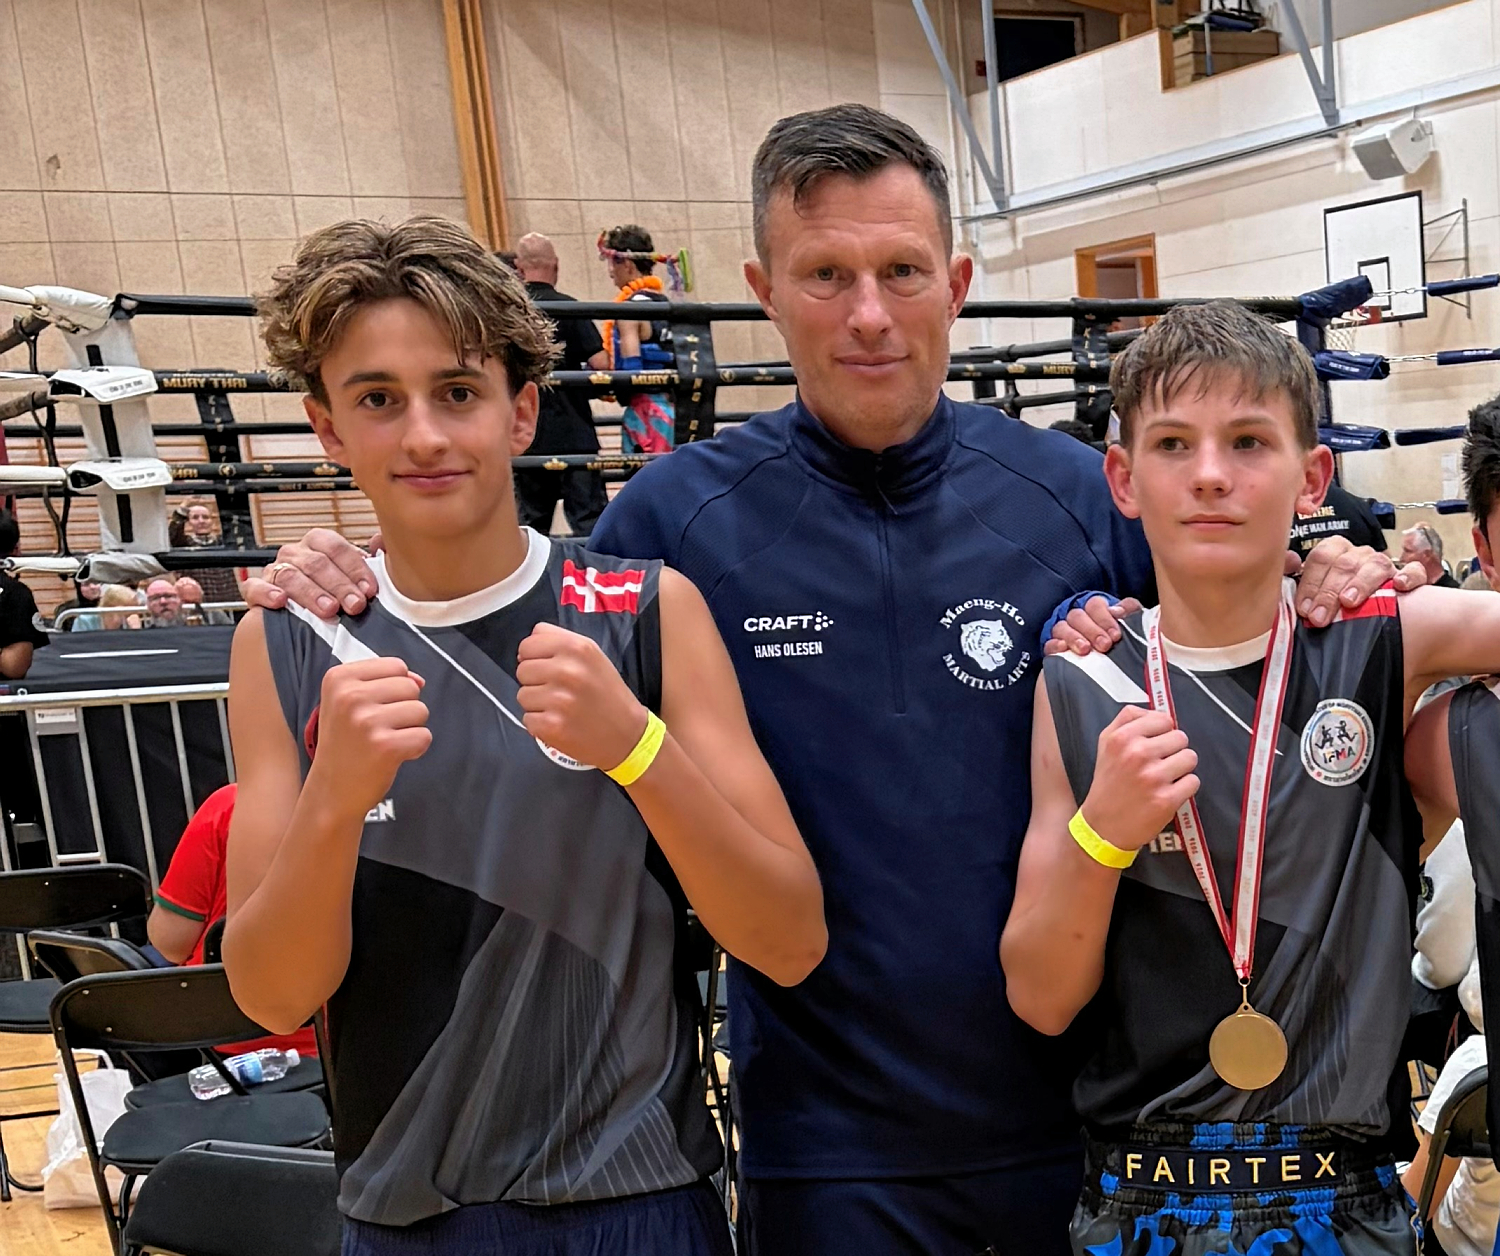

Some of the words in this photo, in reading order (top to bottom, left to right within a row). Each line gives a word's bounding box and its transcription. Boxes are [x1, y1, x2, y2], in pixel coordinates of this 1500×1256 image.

[743, 615, 813, 632] CRAFT
[939, 598, 1026, 629] Maeng-Ho
[754, 643, 782, 659] HANS
[783, 641, 823, 657] OLESEN
[942, 652, 1004, 691] MARTIAL
[1007, 650, 1031, 686] ARTS
[1126, 1151, 1337, 1185] FAIRTEX
